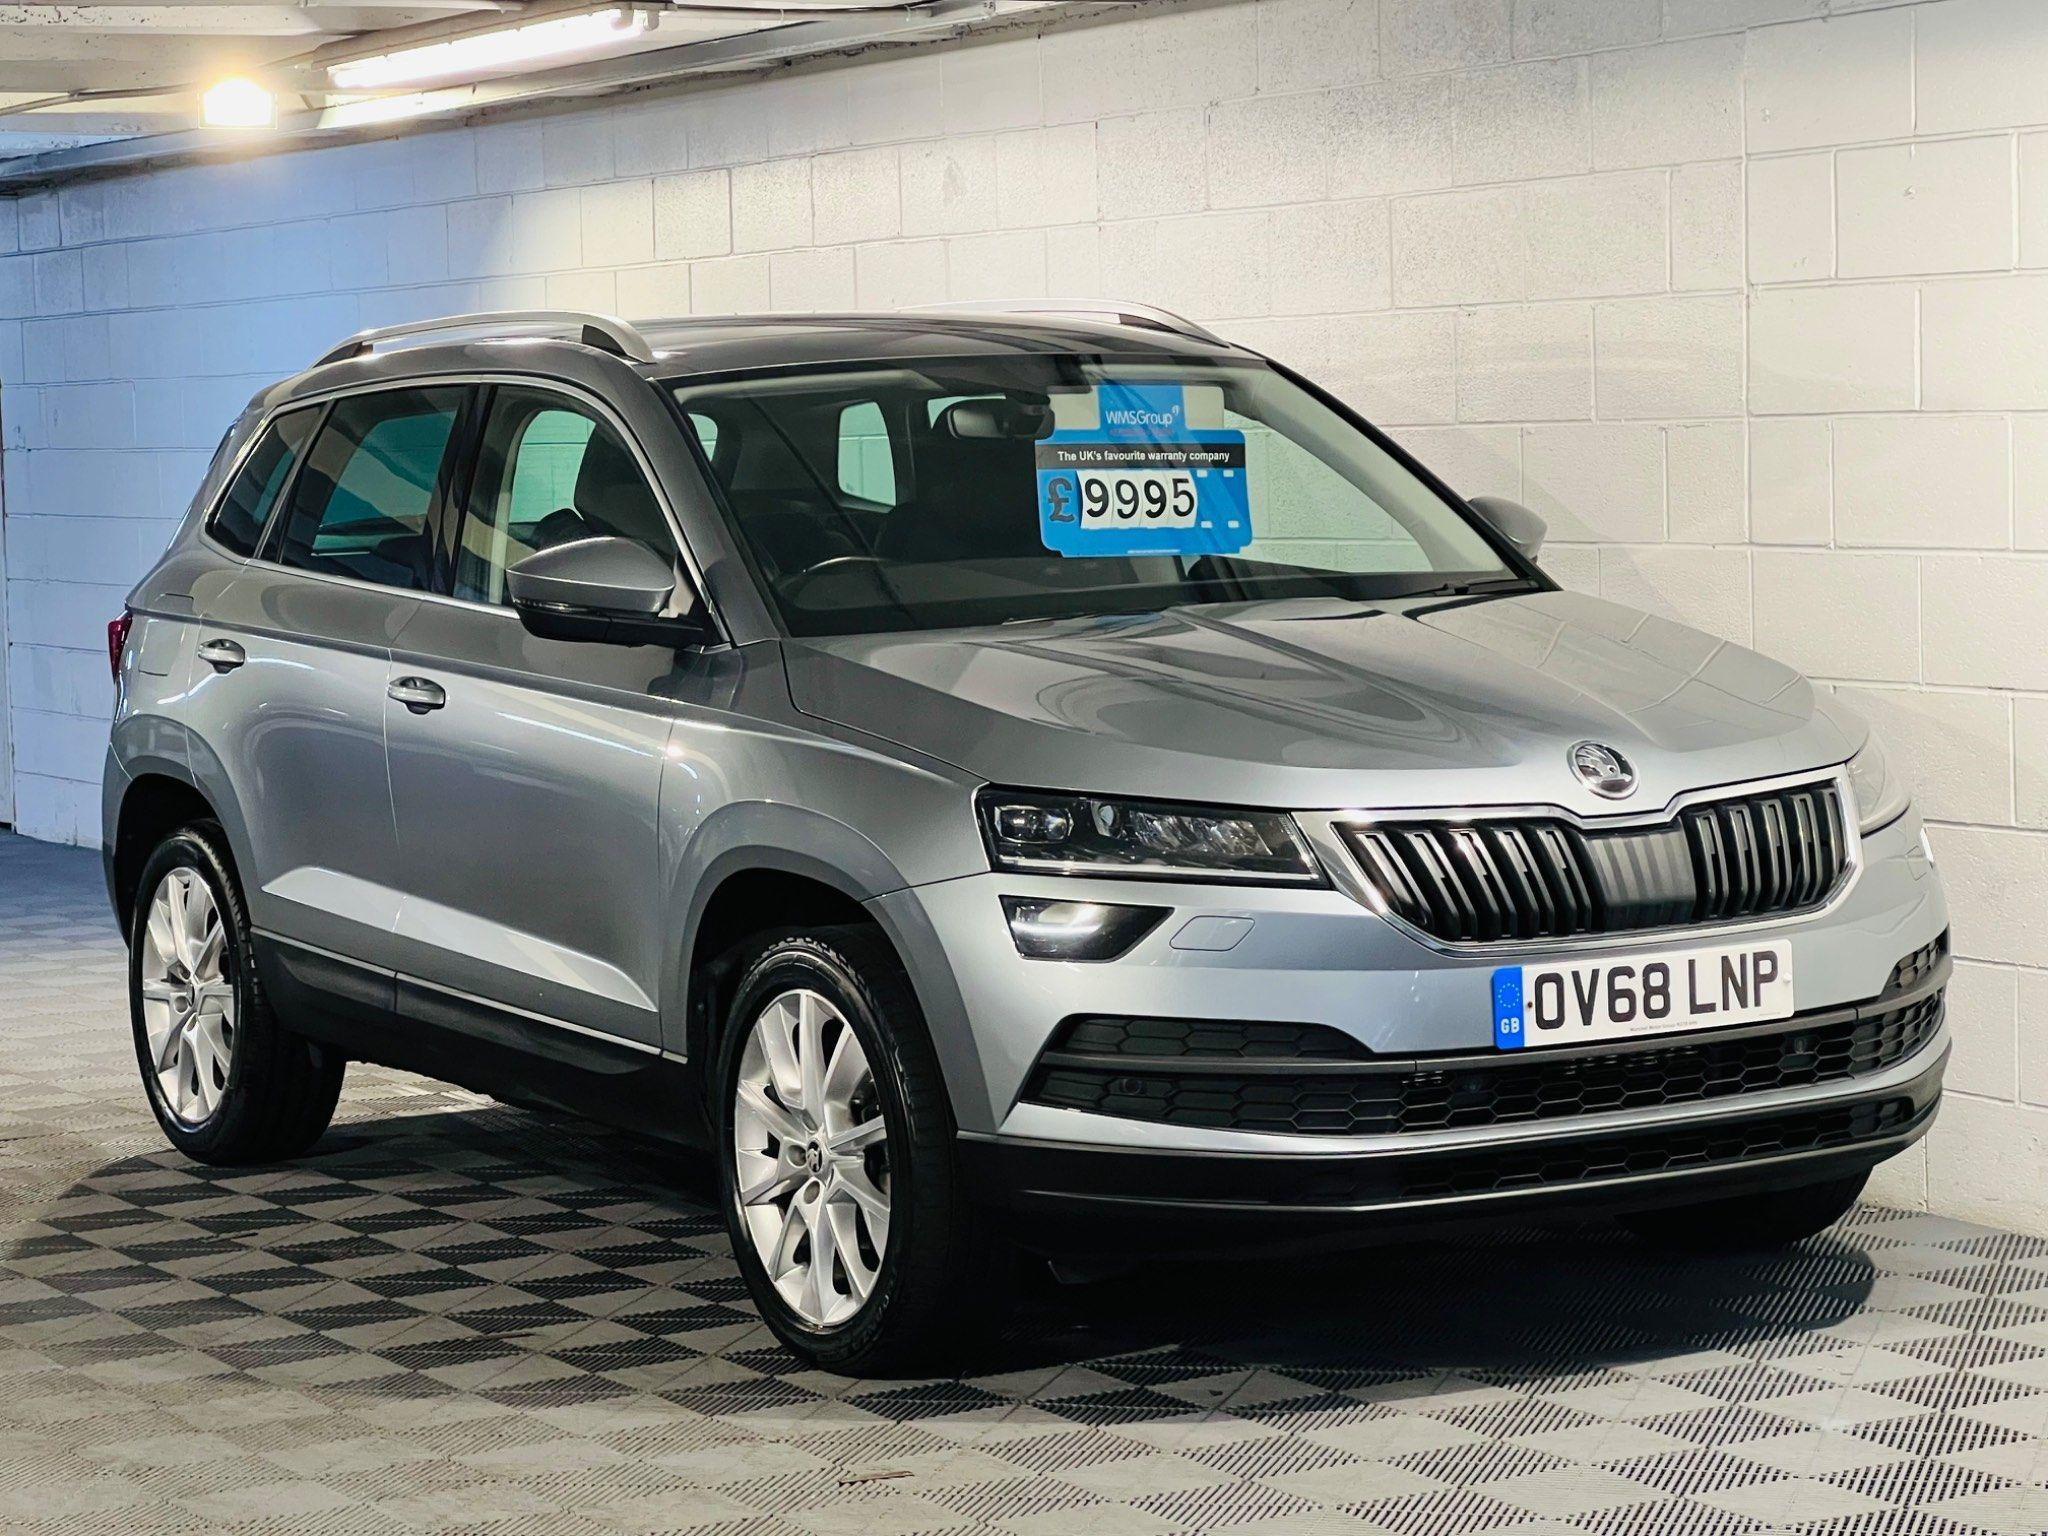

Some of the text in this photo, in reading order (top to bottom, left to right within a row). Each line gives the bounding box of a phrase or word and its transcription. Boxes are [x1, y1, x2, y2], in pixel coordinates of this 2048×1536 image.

[1105, 410, 1173, 428] WMSGroup
[1057, 451, 1230, 463] The UK's favourite warranty company
[1534, 950, 1779, 1030] OV68 LNP
[1500, 1017, 1520, 1034] GB
